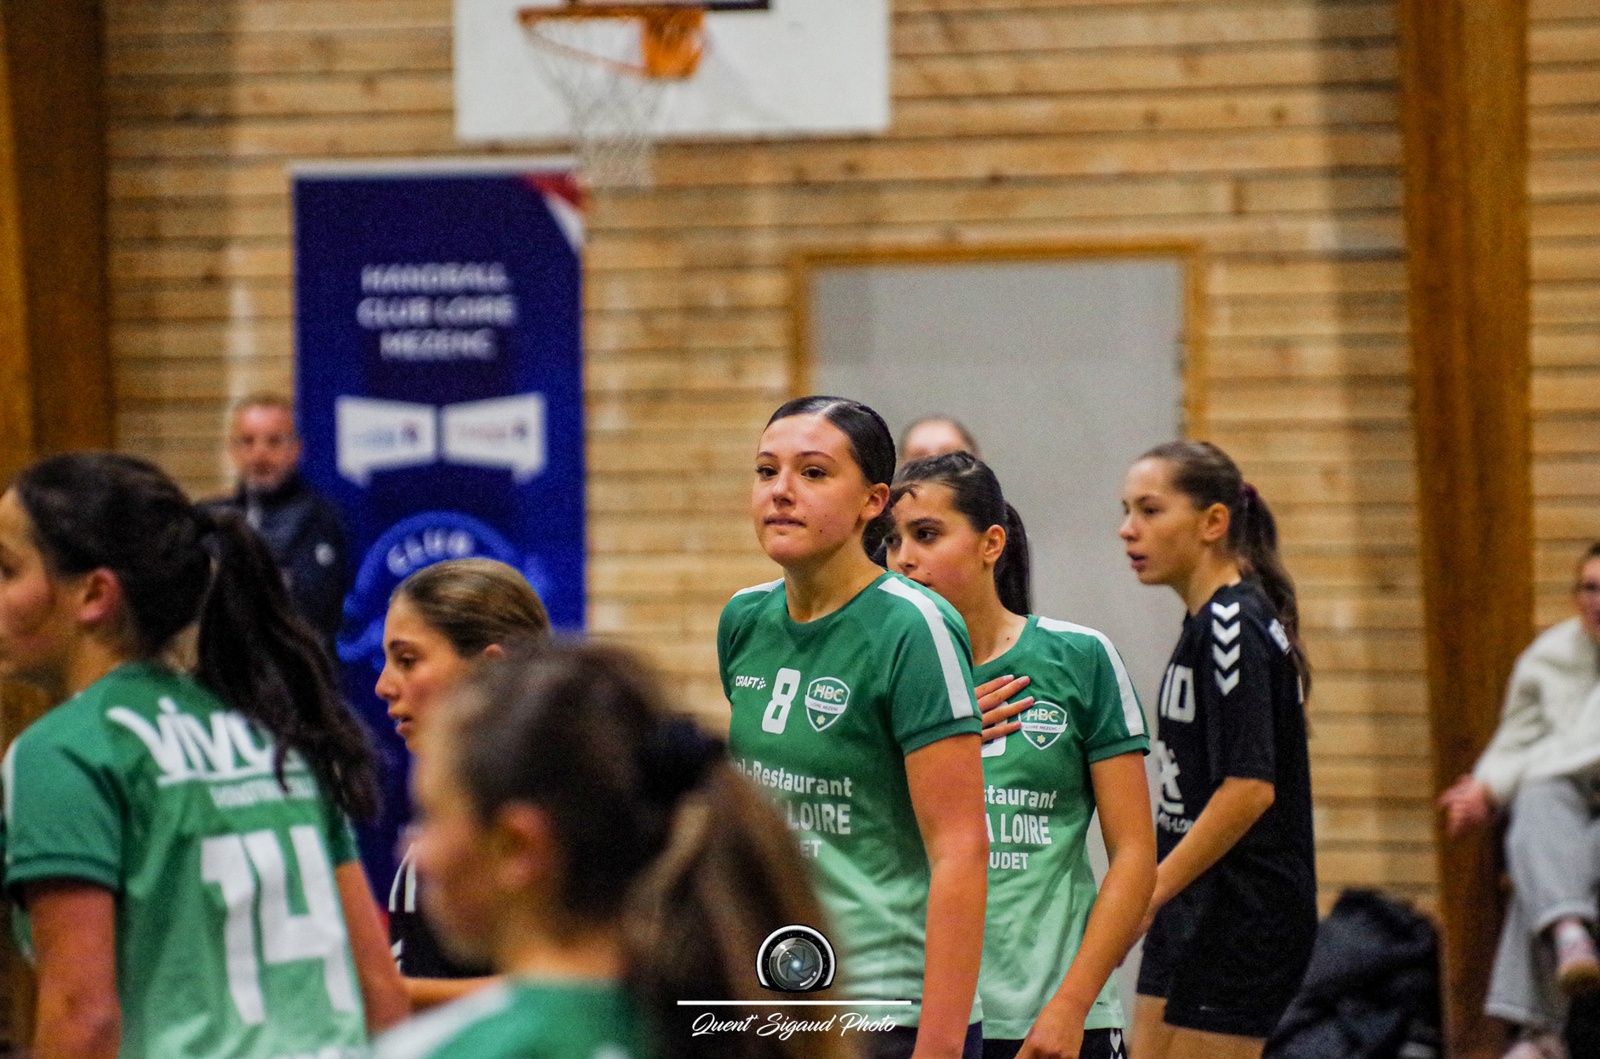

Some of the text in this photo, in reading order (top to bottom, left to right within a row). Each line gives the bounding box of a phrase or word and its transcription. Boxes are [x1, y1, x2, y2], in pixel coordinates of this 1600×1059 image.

[361, 262, 510, 294] HANDBALL
[356, 294, 517, 329] CLUB LOIRE
[386, 527, 475, 577] CLUB
[735, 675, 760, 688] CRAFT
[813, 683, 844, 702] HBC
[1160, 663, 1196, 723] 10
[761, 667, 801, 735] 8
[1026, 708, 1059, 723] HBC
[787, 800, 851, 835] LOIRE
[1000, 813, 1053, 845] LOIRE
[201, 825, 356, 1025] 14
